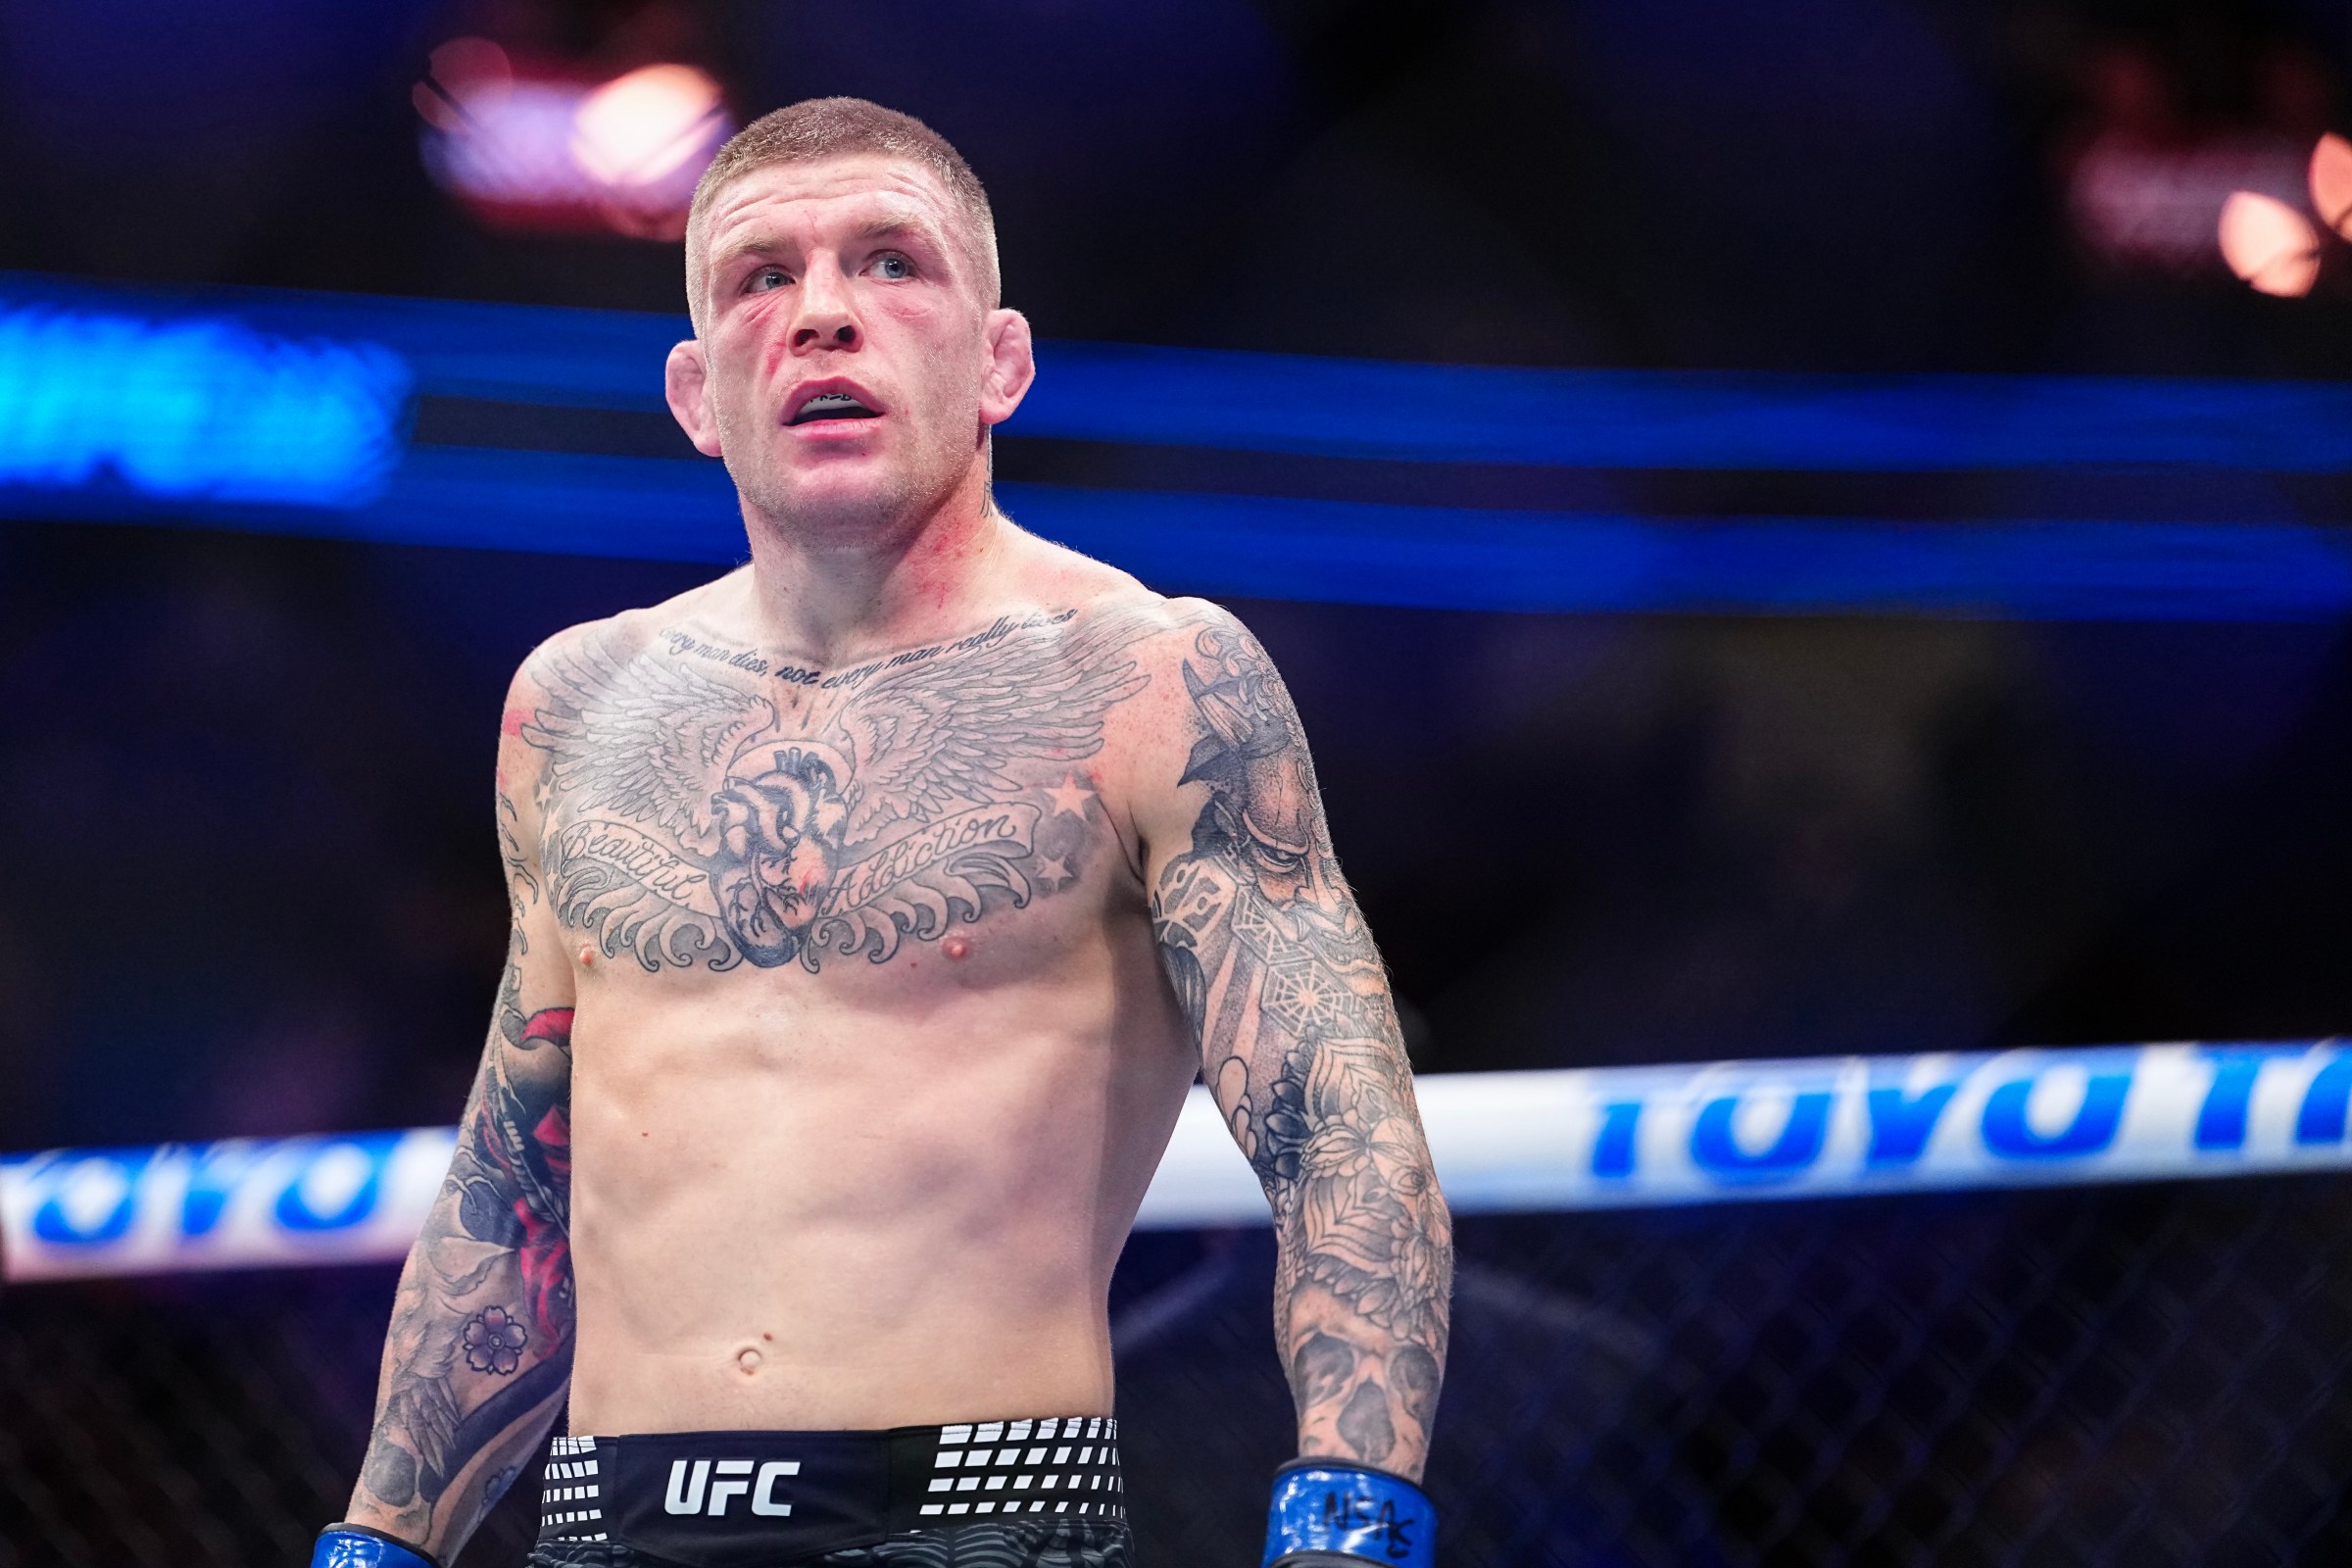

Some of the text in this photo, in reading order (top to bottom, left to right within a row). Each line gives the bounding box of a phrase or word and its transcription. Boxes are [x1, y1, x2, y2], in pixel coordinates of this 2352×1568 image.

[694, 642, 730, 662] man
[728, 649, 769, 676] dies,
[775, 665, 821, 685] not
[821, 661, 883, 690] every
[884, 645, 945, 670] man
[945, 615, 1018, 654] really
[562, 814, 1017, 915] Beautiful Addiction
[663, 1458, 801, 1518] UFC
